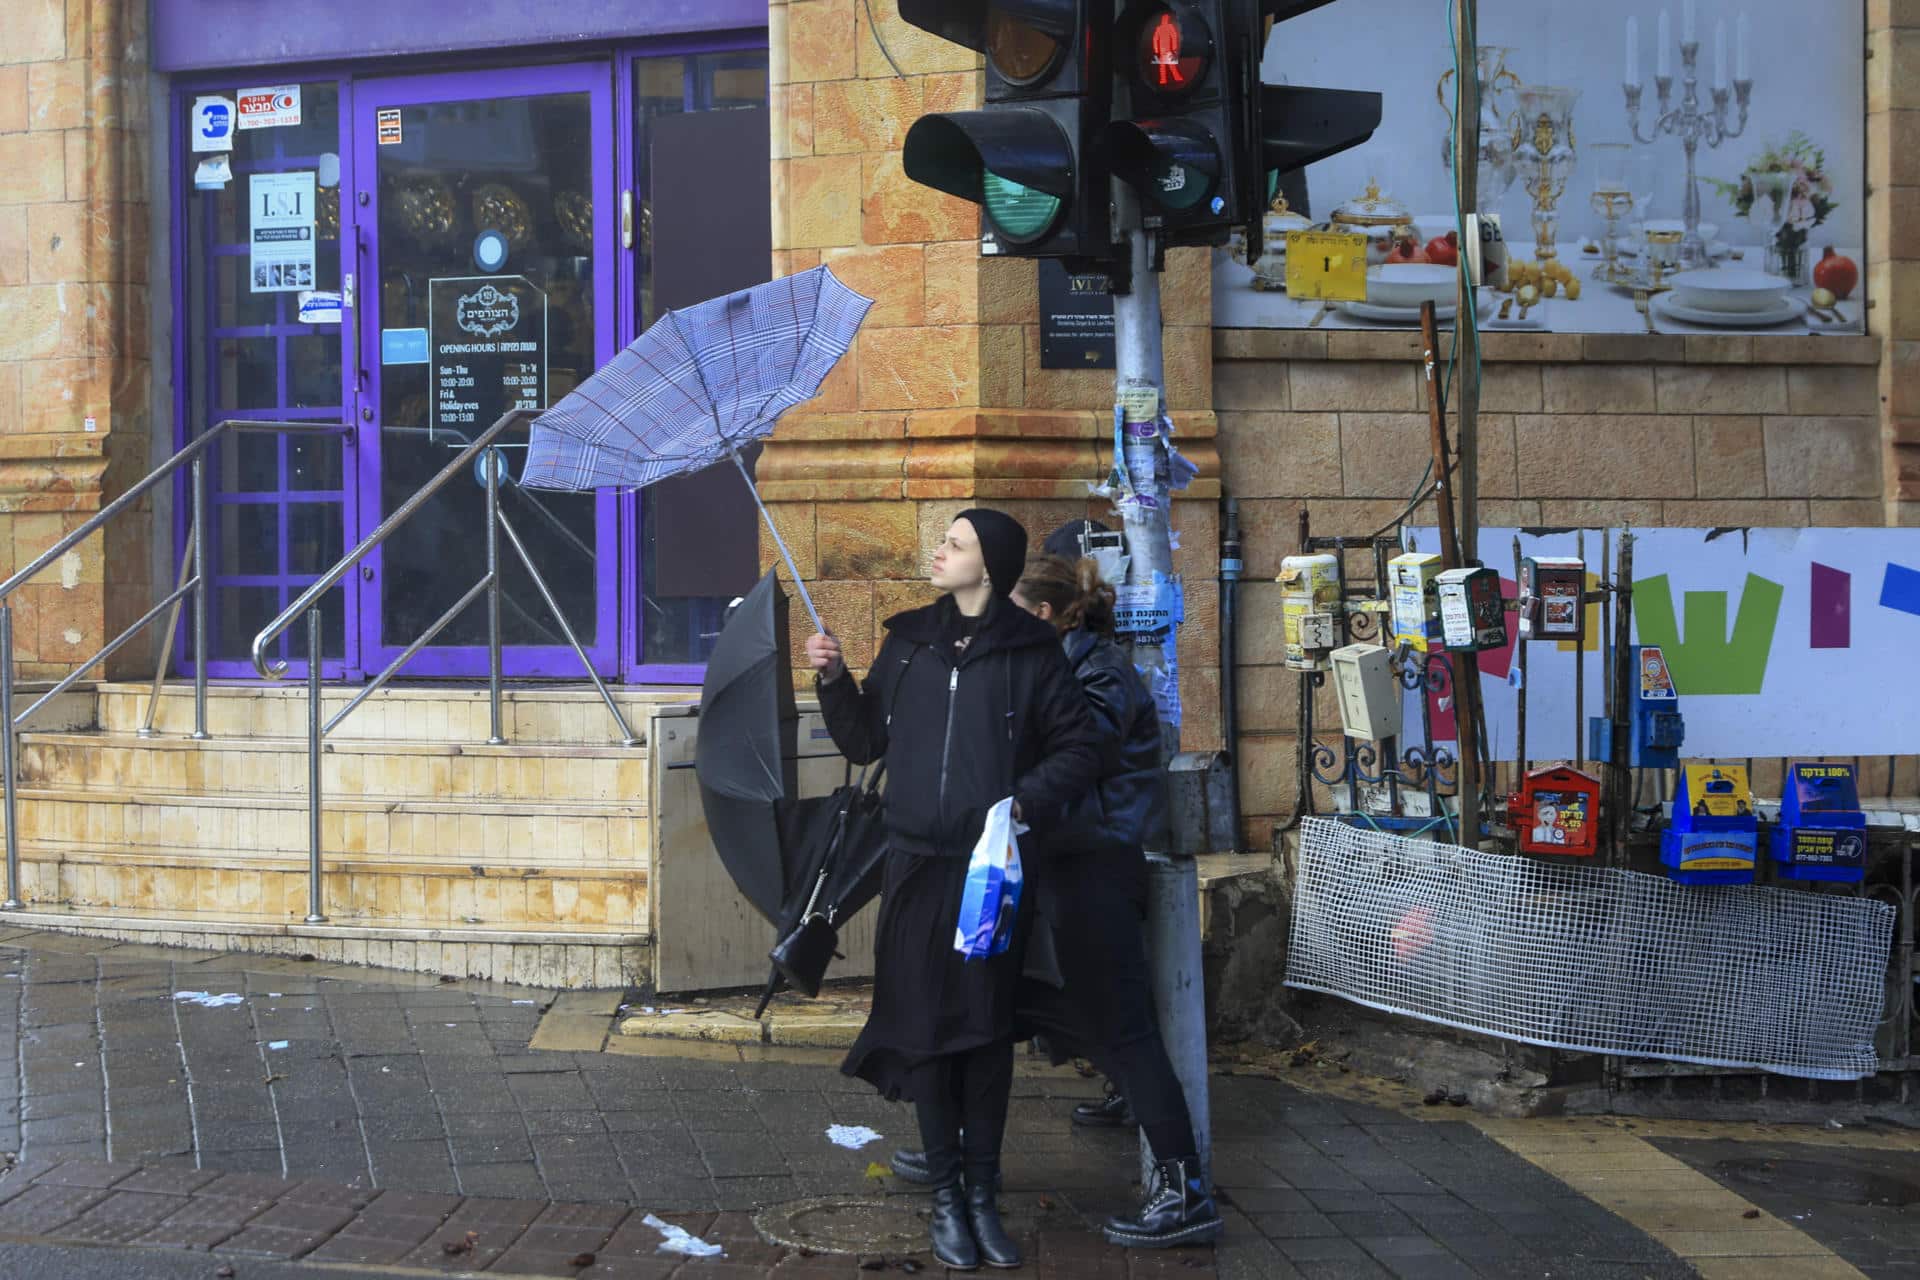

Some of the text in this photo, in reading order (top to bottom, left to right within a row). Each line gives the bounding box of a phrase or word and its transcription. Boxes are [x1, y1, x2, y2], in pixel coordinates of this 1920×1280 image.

[242, 102, 271, 113] מבצר
[466, 308, 508, 319] הצורפים
[440, 343, 496, 354] OPENING HOURS
[440, 401, 479, 412] Holiday eves
[1800, 767, 1850, 778] 100% צדקה
